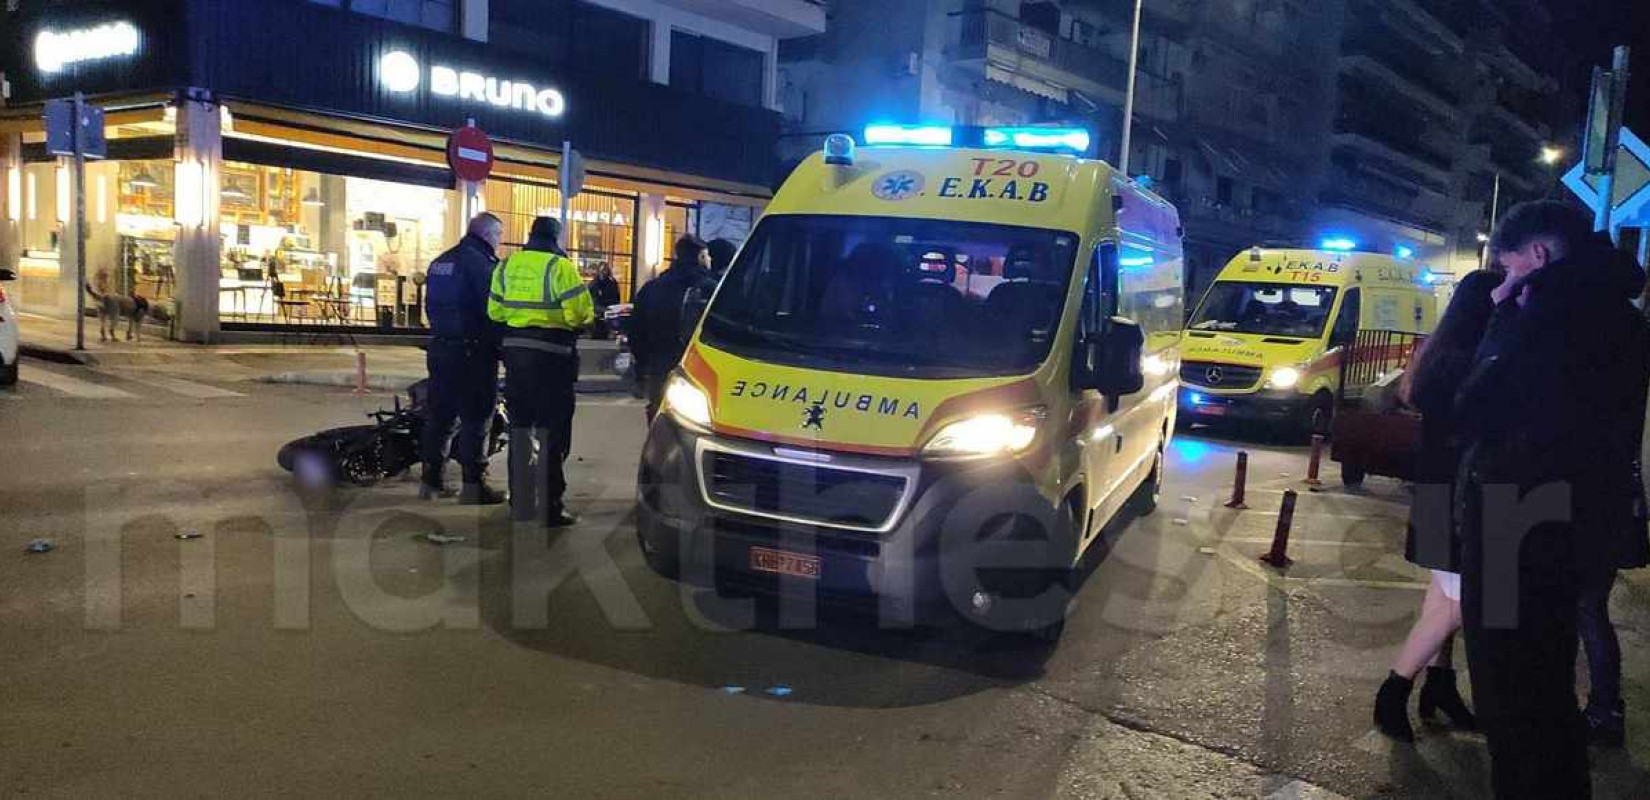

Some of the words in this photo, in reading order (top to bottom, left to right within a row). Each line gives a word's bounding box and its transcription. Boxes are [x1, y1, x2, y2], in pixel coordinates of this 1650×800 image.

[430, 64, 565, 117] BRUNO
[971, 157, 1039, 178] T20
[1290, 271, 1322, 282] T15
